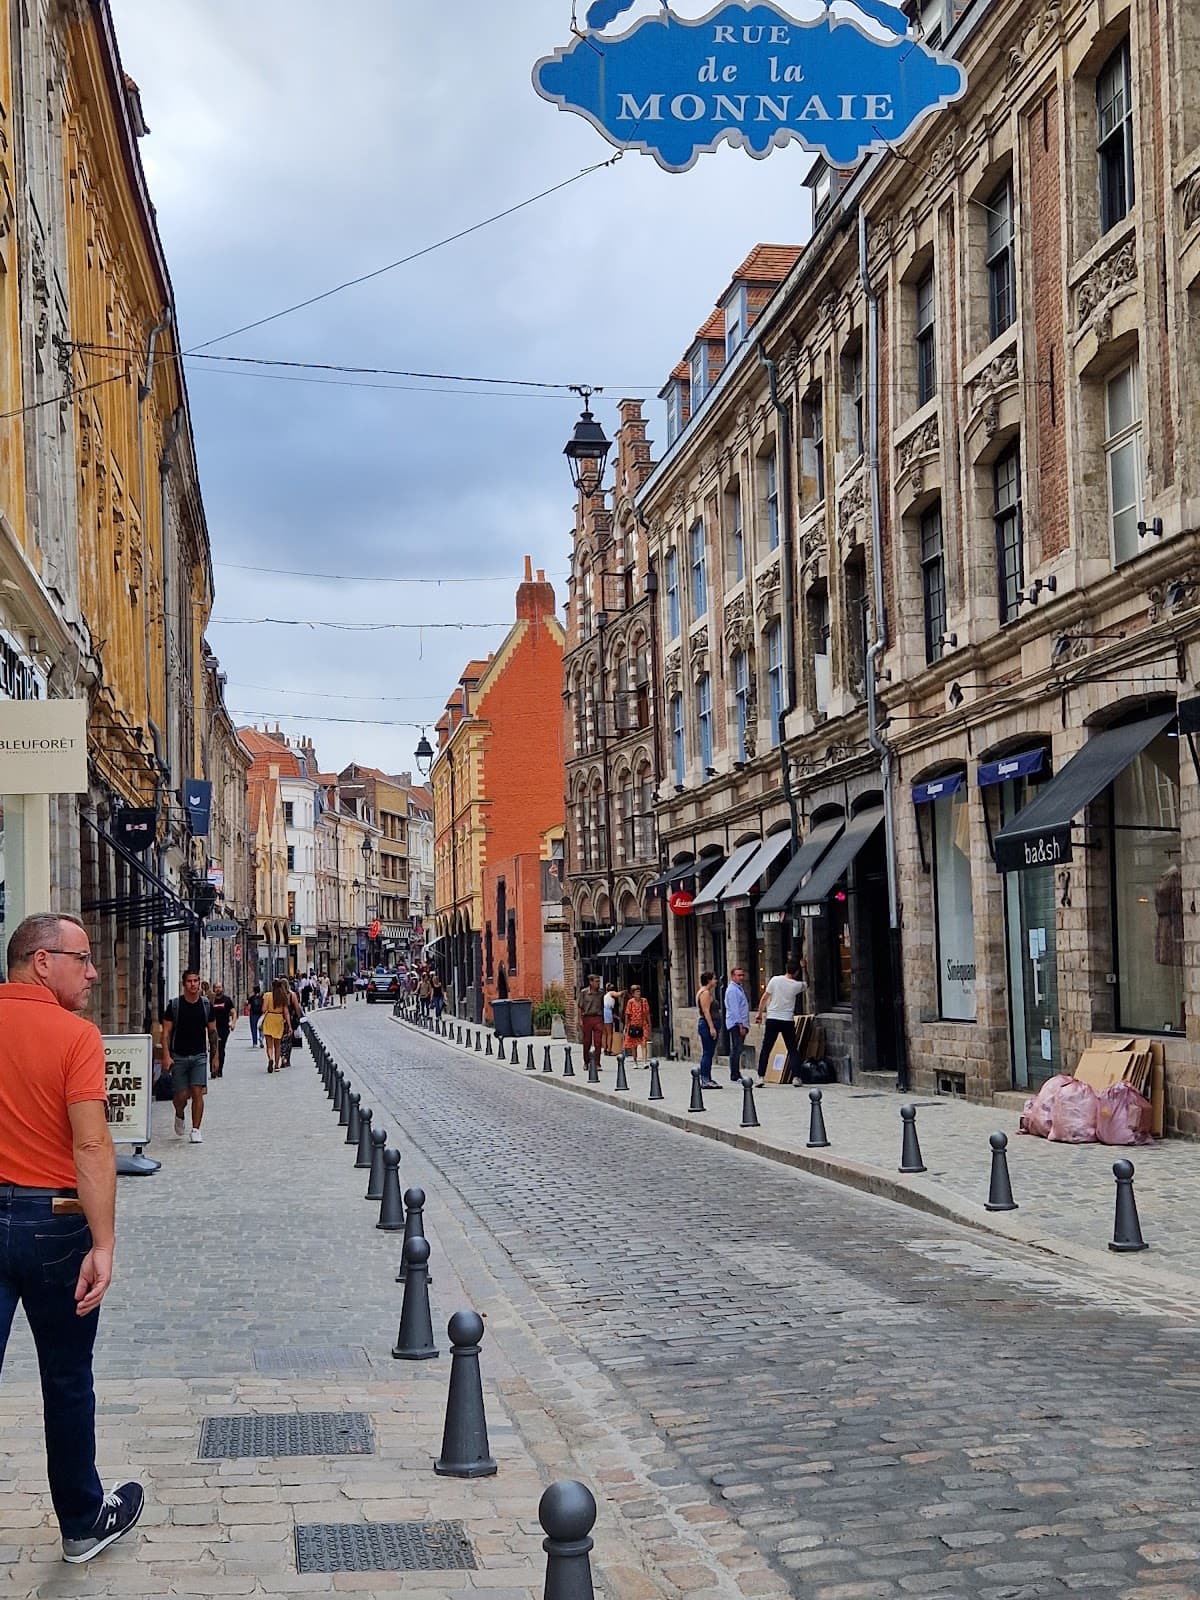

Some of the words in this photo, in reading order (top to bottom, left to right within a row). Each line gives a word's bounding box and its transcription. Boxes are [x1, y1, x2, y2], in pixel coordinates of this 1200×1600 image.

[712, 25, 790, 44] RUE
[698, 56, 737, 83] de
[768, 56, 805, 83] la
[615, 93, 894, 121] MONNAIE
[1024, 835, 1061, 864] ba&sh
[105, 1061, 131, 1075] EY!
[109, 1077, 142, 1091] ARE
